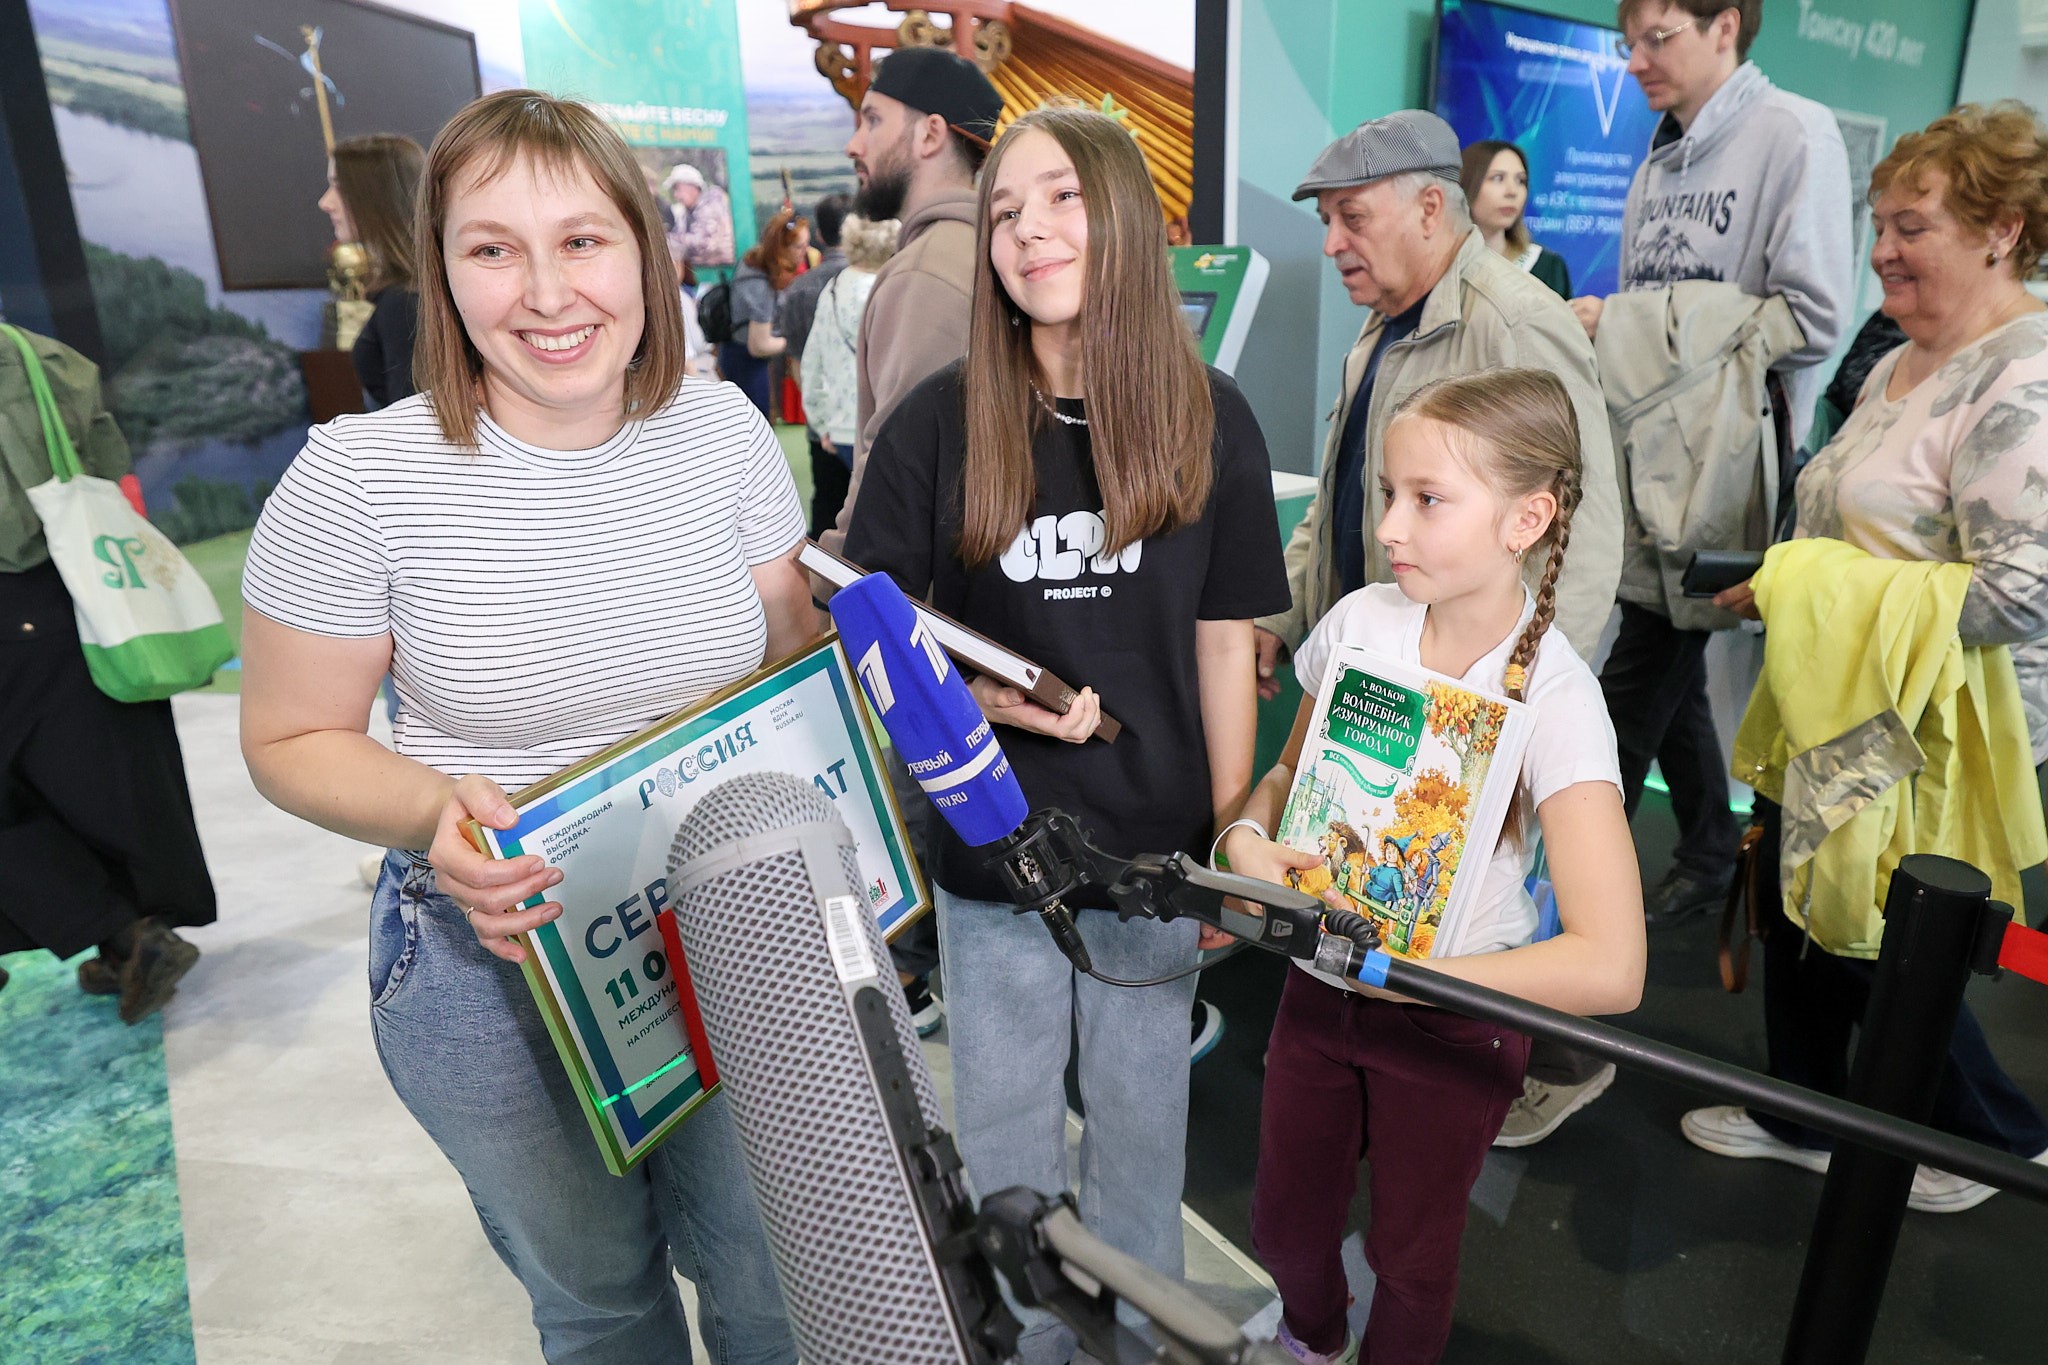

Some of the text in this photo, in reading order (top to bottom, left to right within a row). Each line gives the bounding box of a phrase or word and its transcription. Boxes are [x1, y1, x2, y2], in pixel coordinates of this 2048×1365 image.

[1044, 586, 1098, 600] PROJECT
[1360, 679, 1406, 703] А. ВОЛКОВ
[769, 698, 795, 716] МОСКВА
[772, 710, 789, 723] ВДНХ
[775, 711, 804, 732] RUSSIA.RU
[1342, 692, 1412, 730] ВОЛШЕБНИК
[1331, 704, 1415, 748] ИЗУМРУДНОГО
[1344, 726, 1391, 756] ГОРОДА
[638, 721, 758, 811] РОССИЯ
[936, 791, 968, 809] 1TV.RU
[542, 801, 613, 846] МЕЖДУНАРОДНАЯ
[545, 826, 592, 855] ВЫСТАВКА-
[550, 843, 580, 864] ФОРУМ
[605, 950, 668, 1009] 11 0
[618, 979, 677, 1030] МЕЖДУНА
[626, 1001, 682, 1048] НА ПУТЕШЕСТ
